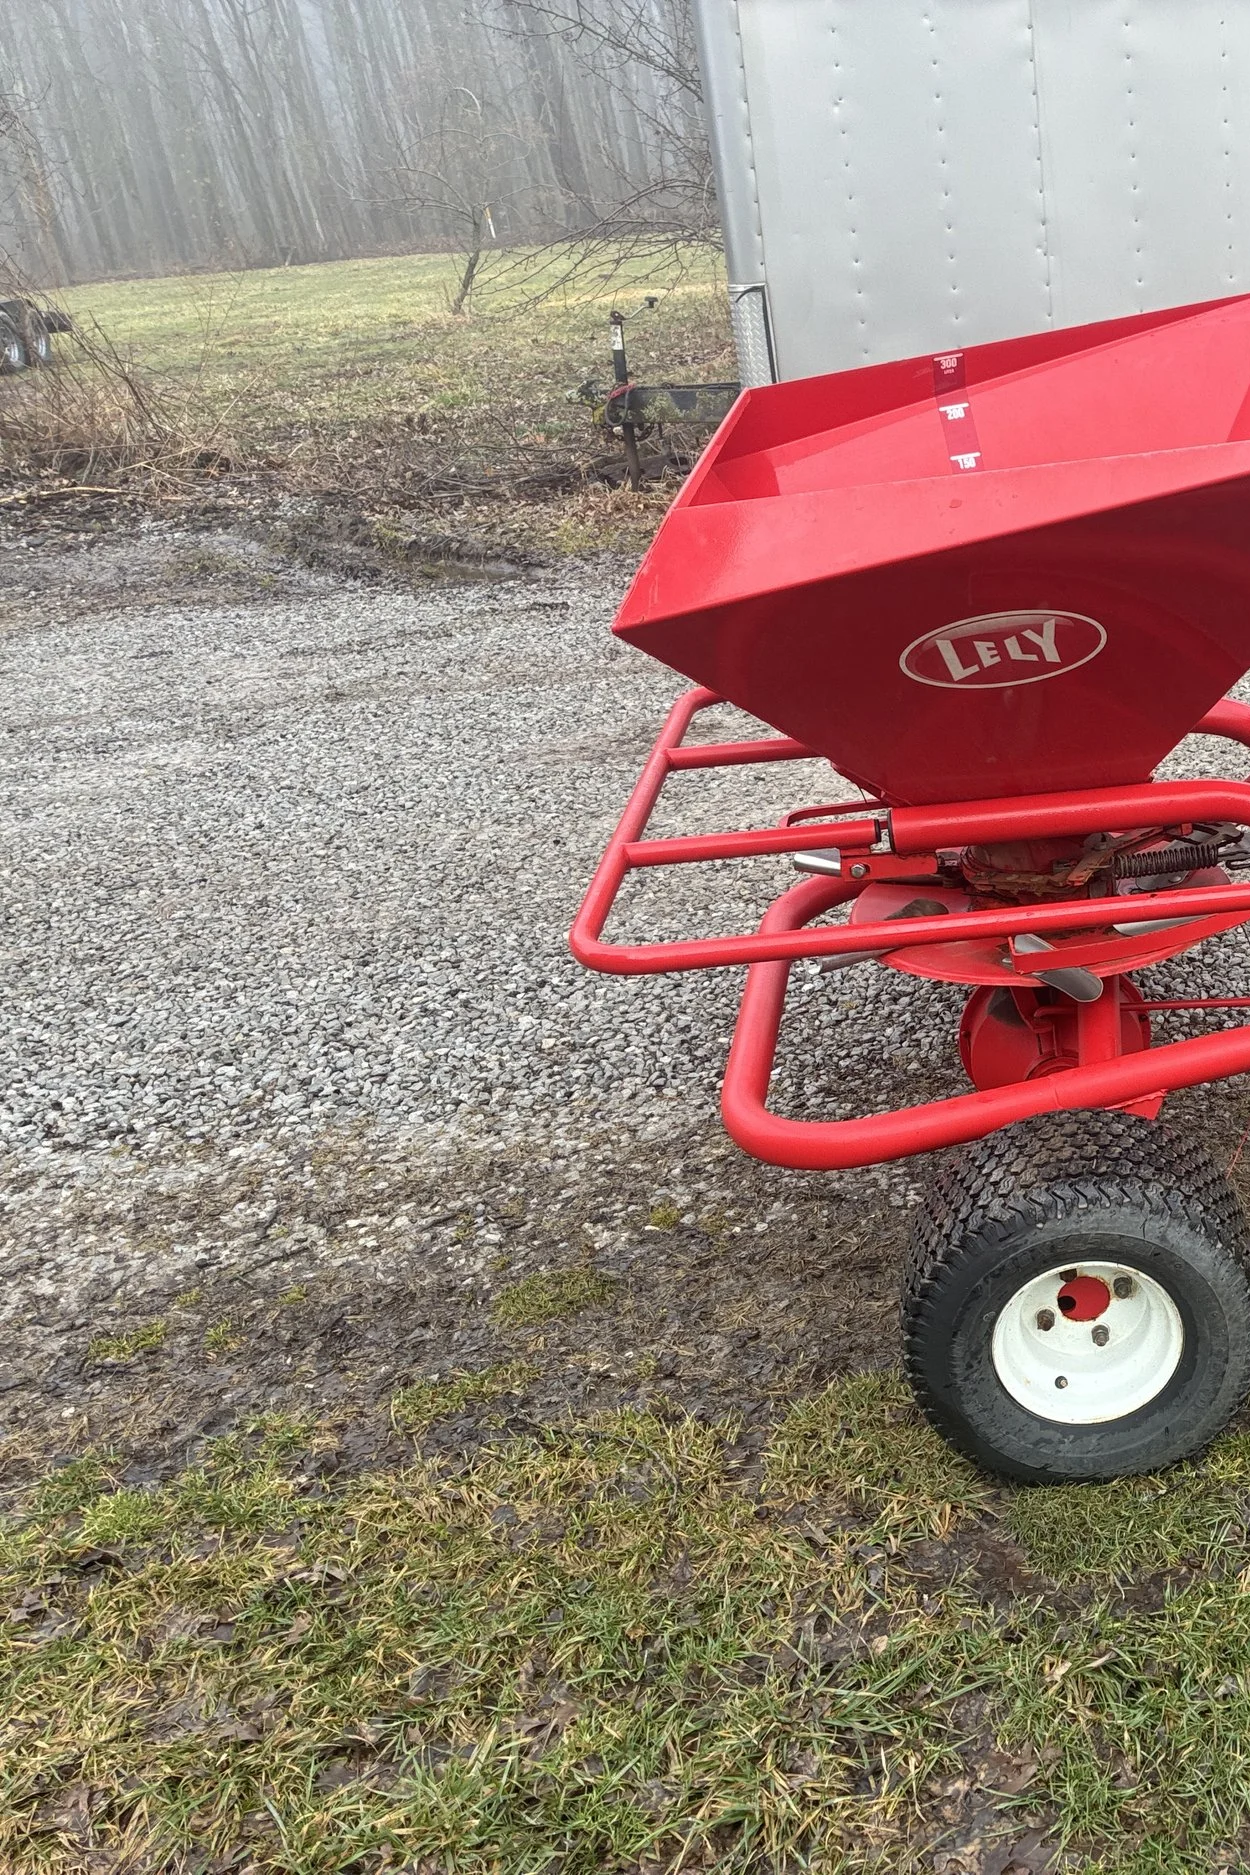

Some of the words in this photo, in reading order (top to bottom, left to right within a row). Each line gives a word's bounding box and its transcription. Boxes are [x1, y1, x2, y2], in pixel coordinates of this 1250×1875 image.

[940, 357, 957, 369] 300
[946, 407, 965, 420] 200
[957, 457, 976, 470] 150
[935, 618, 1062, 682] LELY
